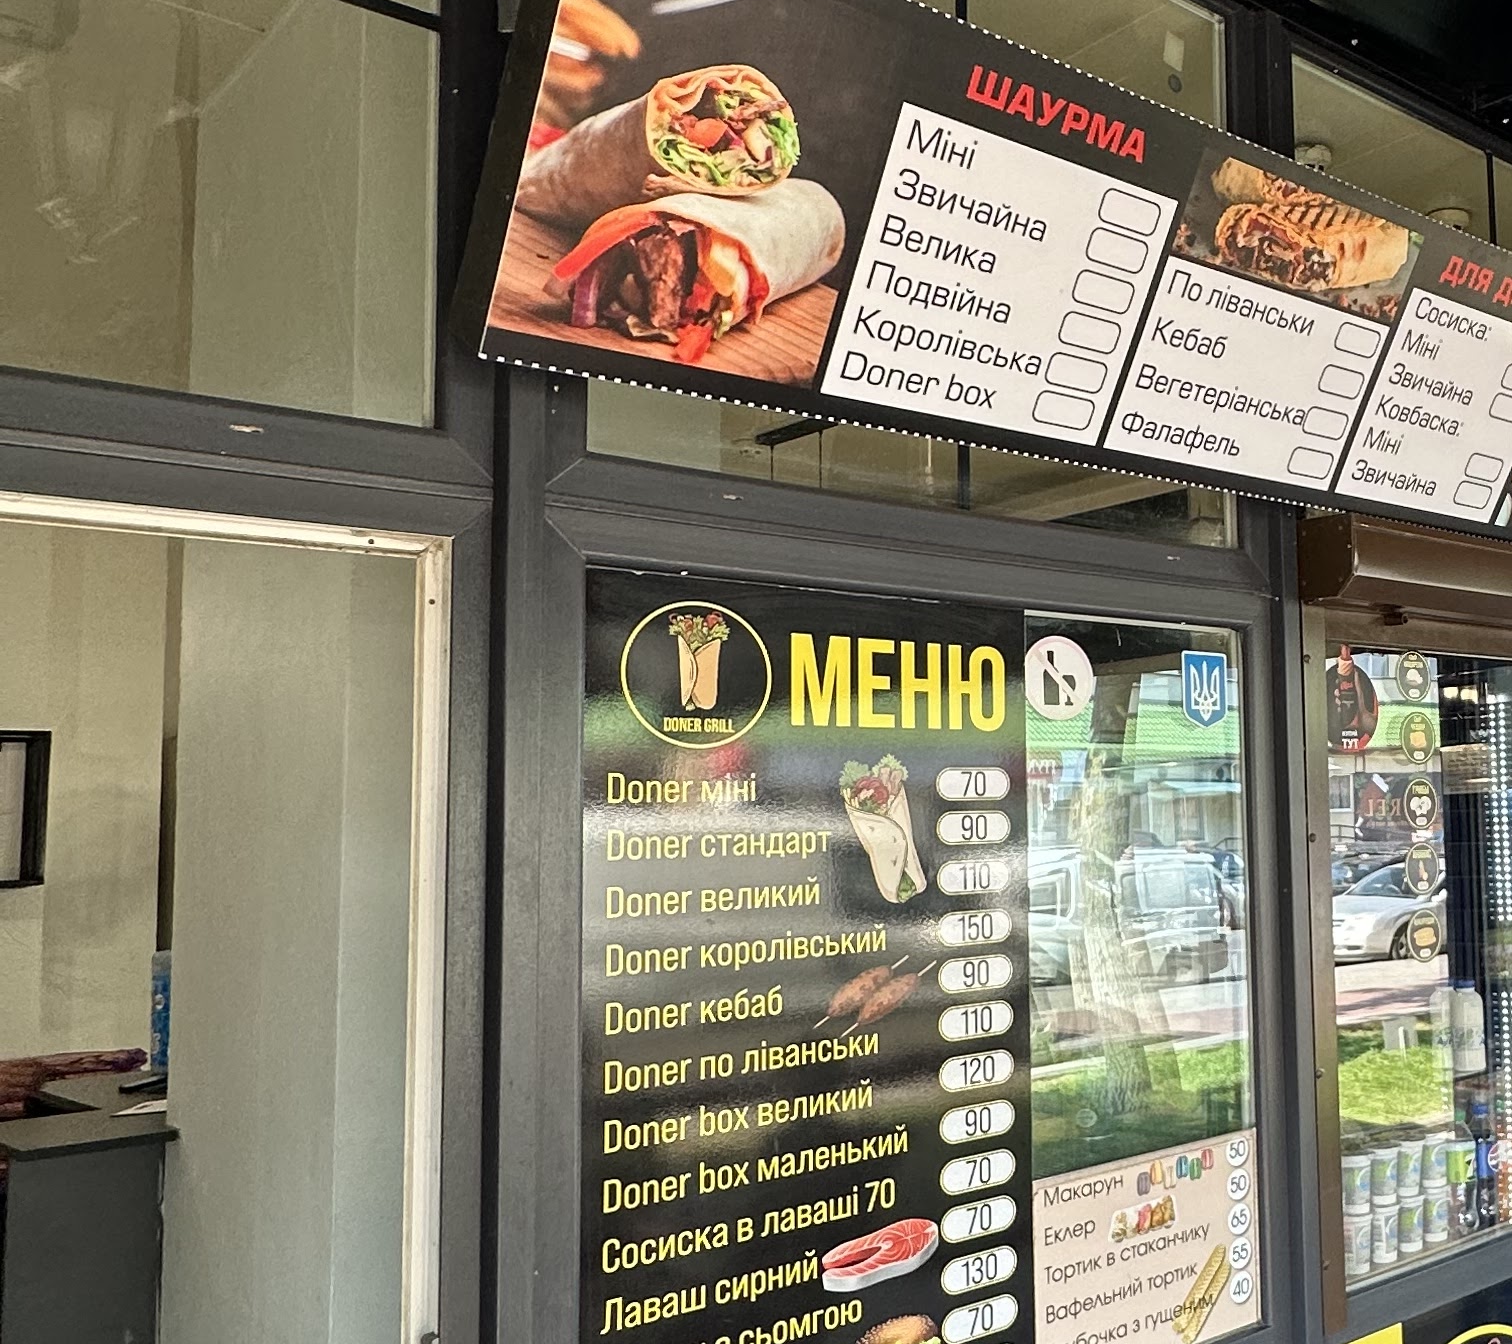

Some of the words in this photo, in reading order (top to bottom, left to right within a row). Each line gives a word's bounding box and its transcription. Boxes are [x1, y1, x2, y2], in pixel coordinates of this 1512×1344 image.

[966, 65, 1148, 163] ШАУРМА
[906, 120, 976, 169] Міні
[894, 169, 1047, 242] Звичайна
[880, 216, 997, 273] Велика
[866, 261, 1011, 324] Подвійна
[1439, 256, 1492, 297] ДЛЯ
[1167, 270, 1204, 302] По
[1207, 285, 1315, 337] ліванськи
[1414, 297, 1492, 341] Сосиска:
[853, 308, 1042, 375] Королівська
[1150, 317, 1227, 359] Кебаб
[1401, 330, 1438, 359] Міні
[840, 352, 939, 396] Doner
[946, 366, 997, 409] box
[1134, 364, 1305, 427] Вегетеріанська
[1388, 364, 1473, 405] Звичайна
[1121, 410, 1241, 459] Фалафель
[1375, 396, 1464, 437] Ковбаска:
[1362, 428, 1401, 456] Міні
[1349, 460, 1438, 497] Звичайна
[790, 632, 1006, 731] МЕНЮ
[663, 717, 701, 732] DONER
[704, 718, 735, 733] GRILL
[607, 772, 689, 804] Doner
[700, 773, 756, 802] міні
[962, 772, 987, 797] 70
[607, 830, 691, 861] Doner
[700, 829, 831, 859] стандарт
[962, 816, 987, 840] 90
[960, 863, 991, 889] 110
[606, 885, 692, 919] Doner
[700, 877, 819, 910] великий
[958, 914, 993, 940] 150
[605, 942, 691, 977] Doner
[700, 924, 886, 970] королівський
[962, 960, 989, 986] 90
[605, 999, 690, 1035] Doner
[700, 985, 783, 1024] кебаб
[962, 1006, 992, 1033] 110
[604, 1058, 691, 1095] Doner
[699, 1053, 731, 1080] по
[741, 1033, 879, 1075] ліванськи
[961, 1055, 995, 1083] 120
[604, 1116, 691, 1153] Doner
[699, 1105, 749, 1137] box
[758, 1079, 873, 1126] великий
[966, 1108, 991, 1136] 90
[603, 1173, 691, 1213] Doner
[699, 1163, 749, 1196] box
[757, 1125, 908, 1182] маленький
[1229, 1141, 1245, 1158] 50
[967, 1157, 991, 1184] 70
[1230, 1174, 1246, 1193] 50
[1044, 1175, 1123, 1207] Макарун
[602, 1220, 728, 1273] Сосиска
[738, 1217, 753, 1238] в
[761, 1193, 858, 1238] лаваші
[866, 1179, 895, 1212] 70
[967, 1204, 993, 1232] 70
[1045, 1220, 1095, 1246] Еклер
[1231, 1209, 1247, 1227] 65
[963, 1254, 997, 1284] 130
[1045, 1256, 1102, 1284] Тортик
[1107, 1253, 1115, 1266] в
[1120, 1223, 1209, 1261] стаканчику
[1233, 1243, 1248, 1261] 55
[601, 1284, 707, 1334] Лаваш
[715, 1251, 818, 1305] сирний
[1046, 1278, 1143, 1323] Вафельний
[1147, 1263, 1197, 1292] тортик
[1233, 1278, 1249, 1295] 40
[968, 1305, 994, 1333] 70
[1132, 1318, 1140, 1333] з
[1145, 1293, 1213, 1331] гущеним
